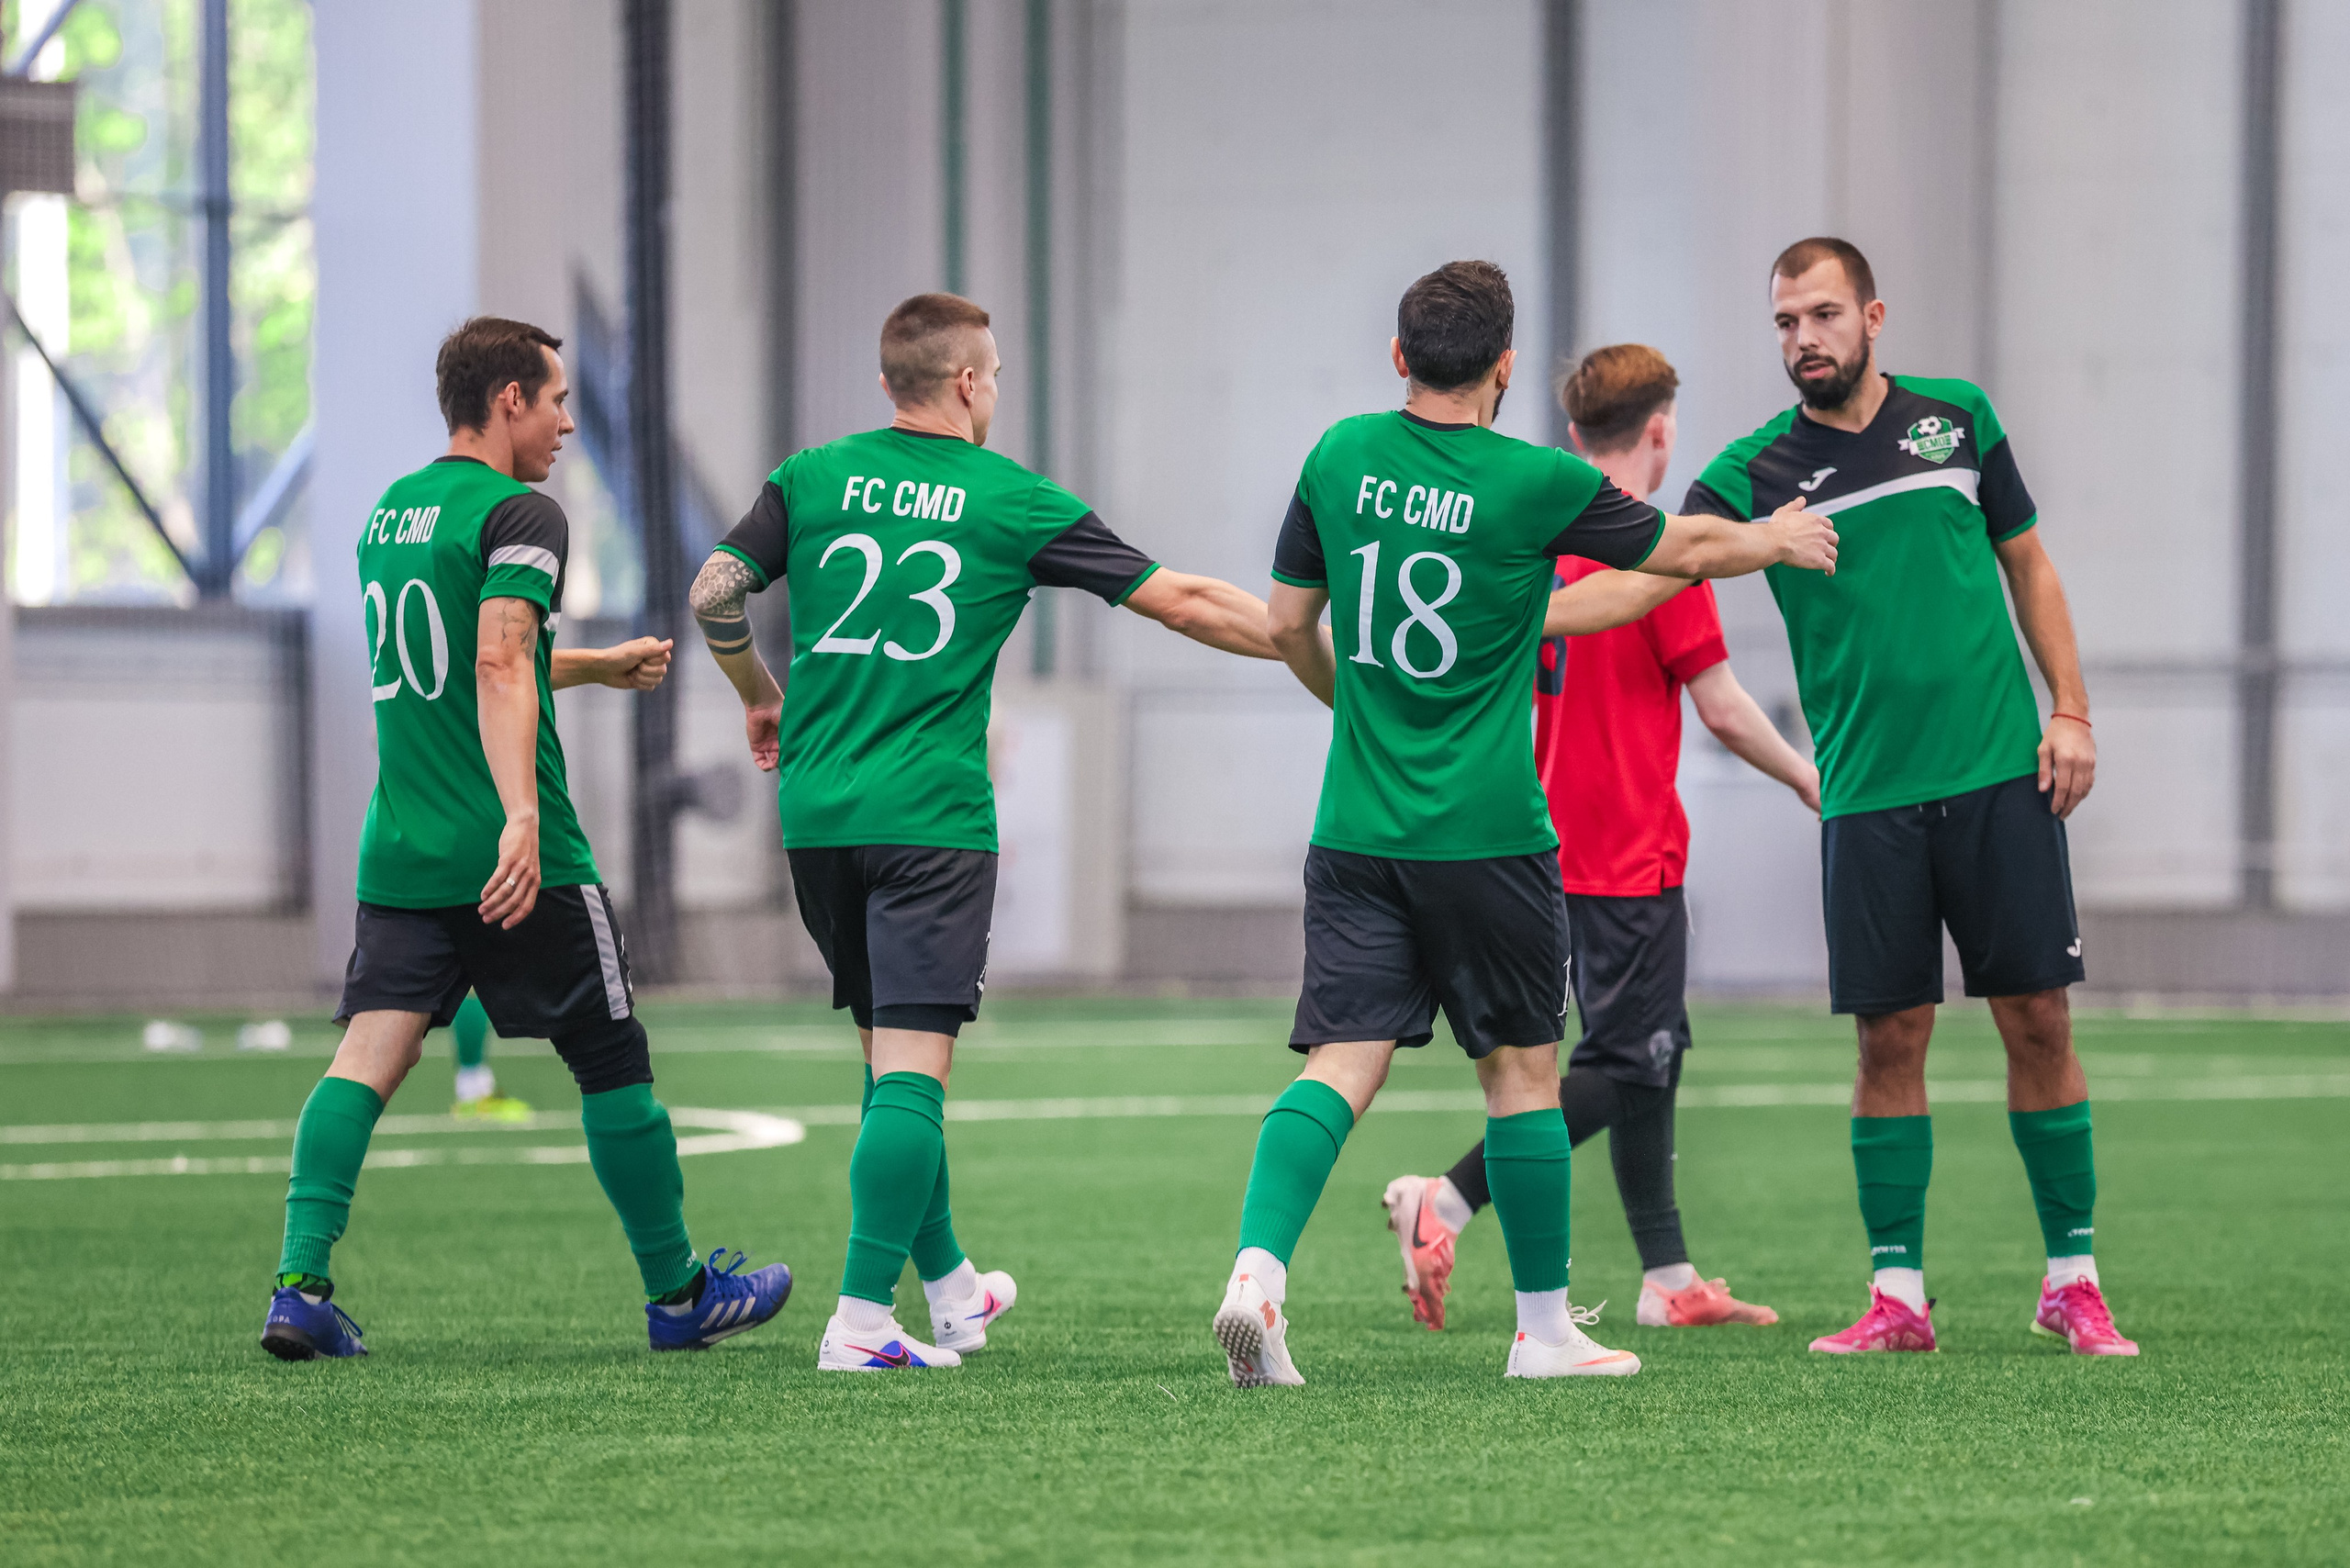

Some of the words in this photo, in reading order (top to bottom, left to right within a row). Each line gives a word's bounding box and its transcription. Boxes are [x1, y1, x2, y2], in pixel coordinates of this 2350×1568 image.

[367, 508, 397, 544] FC
[395, 505, 441, 544] CMD
[841, 476, 886, 513] FC
[891, 480, 967, 522] CMD
[1356, 475, 1398, 519] FC
[1403, 485, 1475, 534] CMD
[364, 577, 449, 703] 20
[811, 532, 962, 661] 23
[1348, 540, 1462, 678] 18
